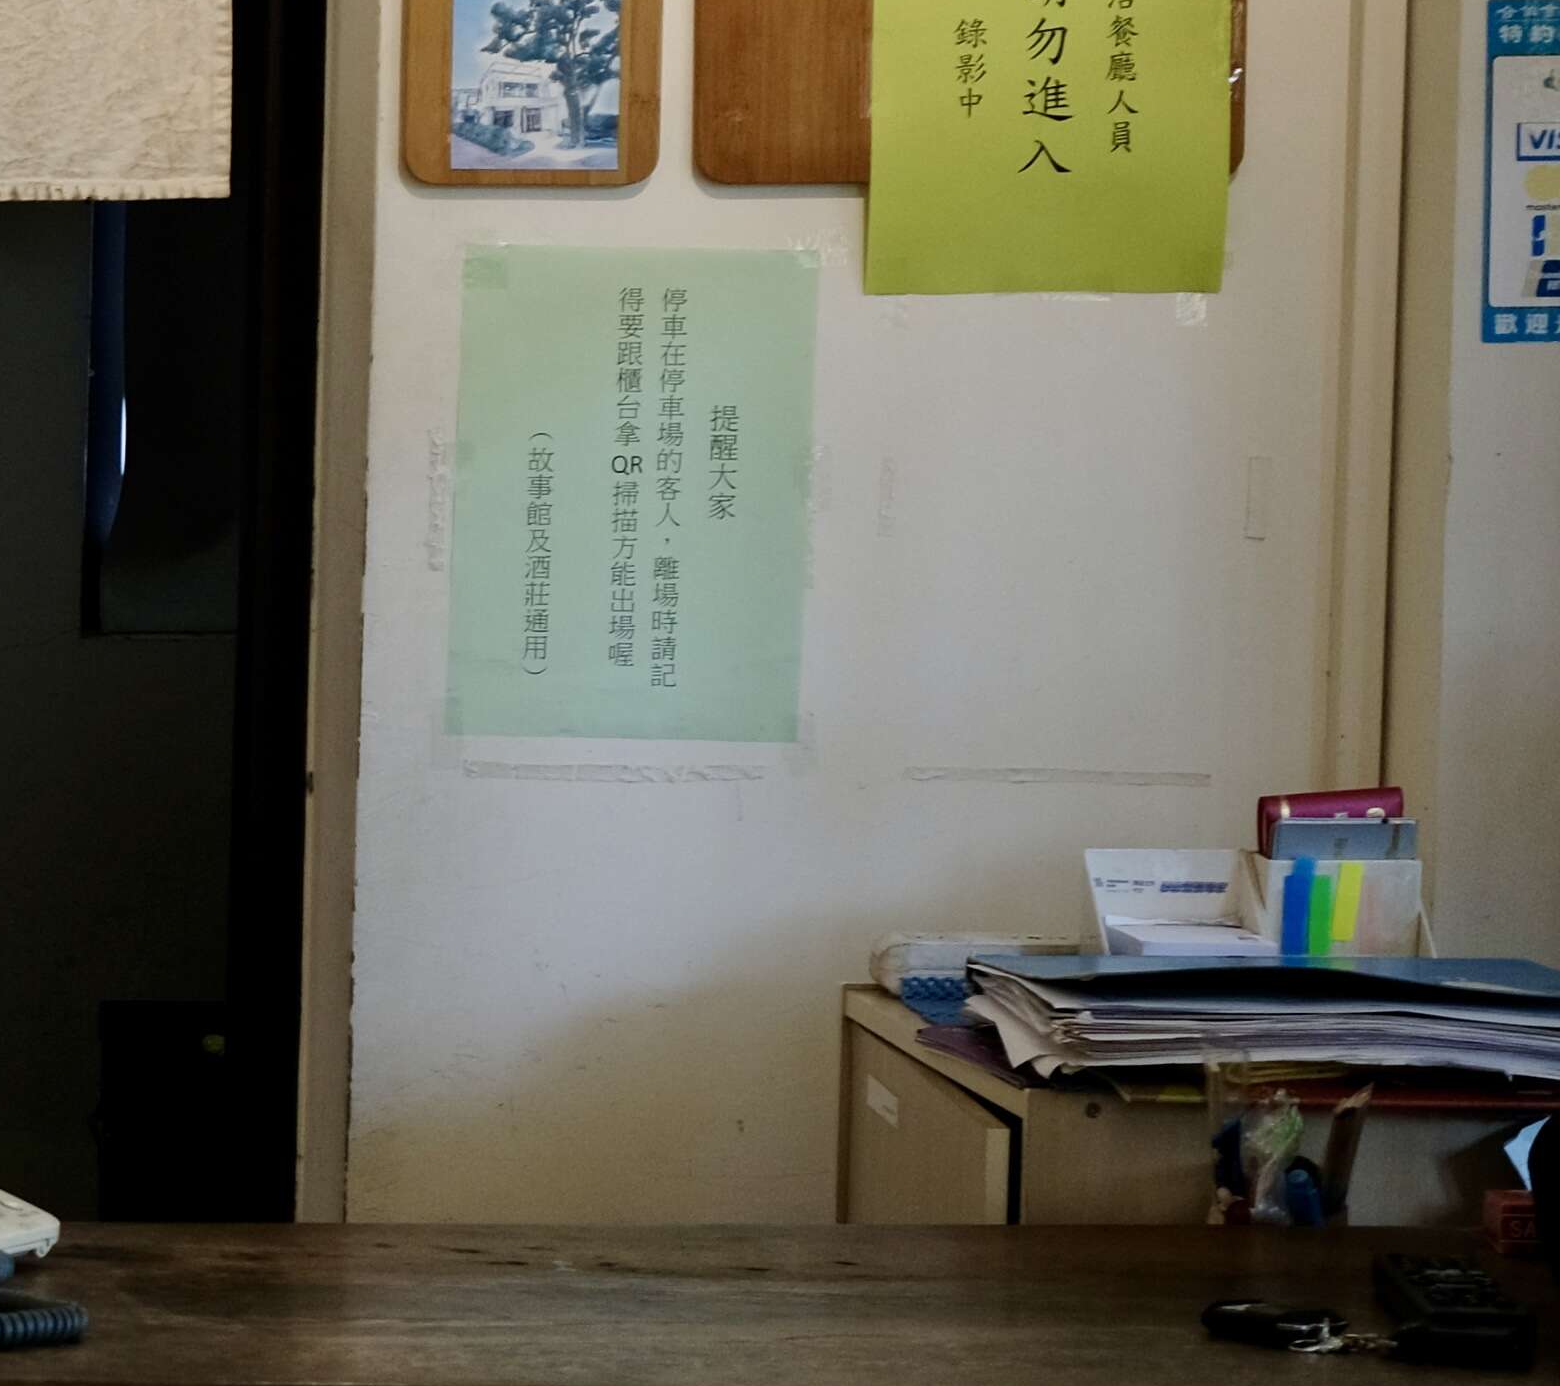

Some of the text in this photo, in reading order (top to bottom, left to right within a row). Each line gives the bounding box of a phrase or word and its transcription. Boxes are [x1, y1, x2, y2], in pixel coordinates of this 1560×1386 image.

[1498, 24, 1560, 44] 特約
[954, 18, 988, 119] 錄影中
[1530, 129, 1560, 149] VI
[1494, 313, 1560, 335] 歡迎
[649, 285, 690, 690] 停車在停車場的客人，離場時請記
[707, 404, 741, 521] 提醒大家
